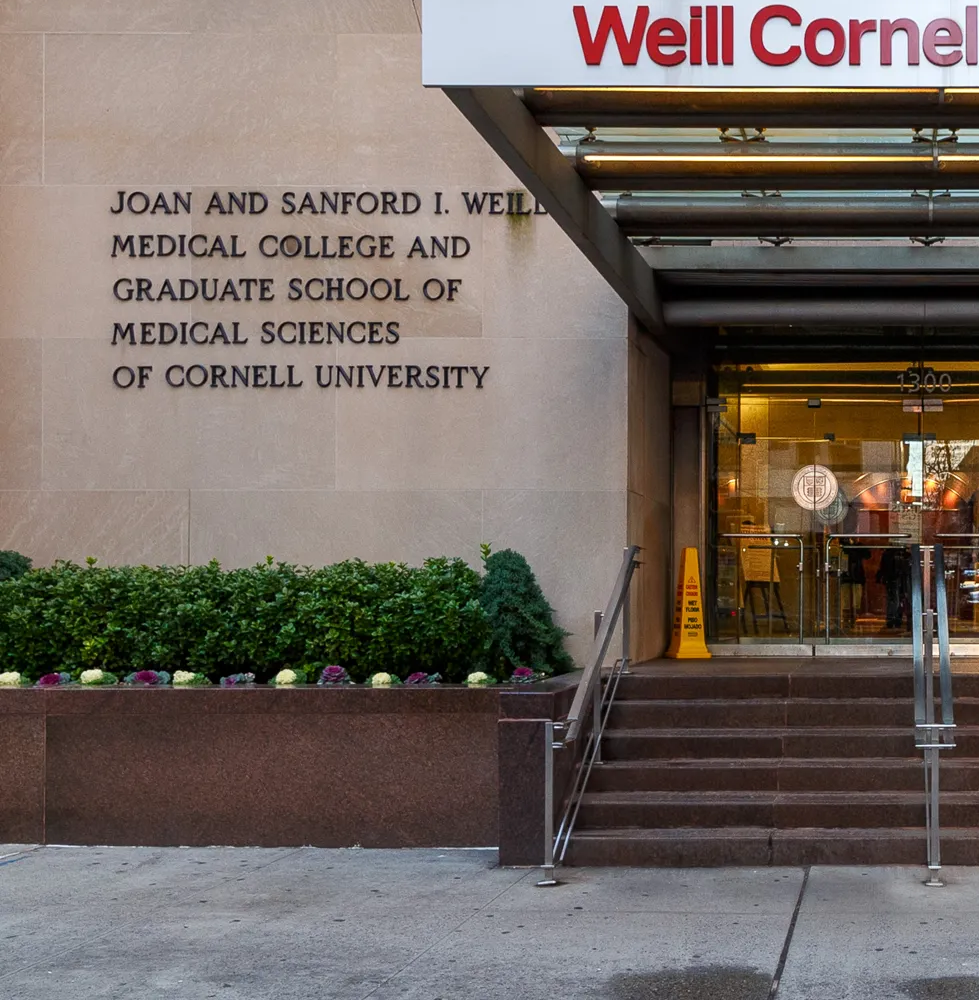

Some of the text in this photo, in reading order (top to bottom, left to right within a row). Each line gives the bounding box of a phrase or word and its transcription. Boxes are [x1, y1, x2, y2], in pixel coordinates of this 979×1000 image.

[573, 4, 734, 67] Weill
[111, 191, 194, 216] JOAN
[205, 192, 270, 216] AND
[282, 192, 423, 216] SANFORD
[435, 192, 451, 216] I.
[111, 234, 472, 260] MEDICAL COLLEGE AND
[113, 278, 464, 303] GRADUATE SCHOOL OF
[111, 321, 401, 346] MEDICAL SCIENCES
[113, 365, 491, 390] OF CORNELL UNIVERSITY
[897, 373, 952, 393] 1300
